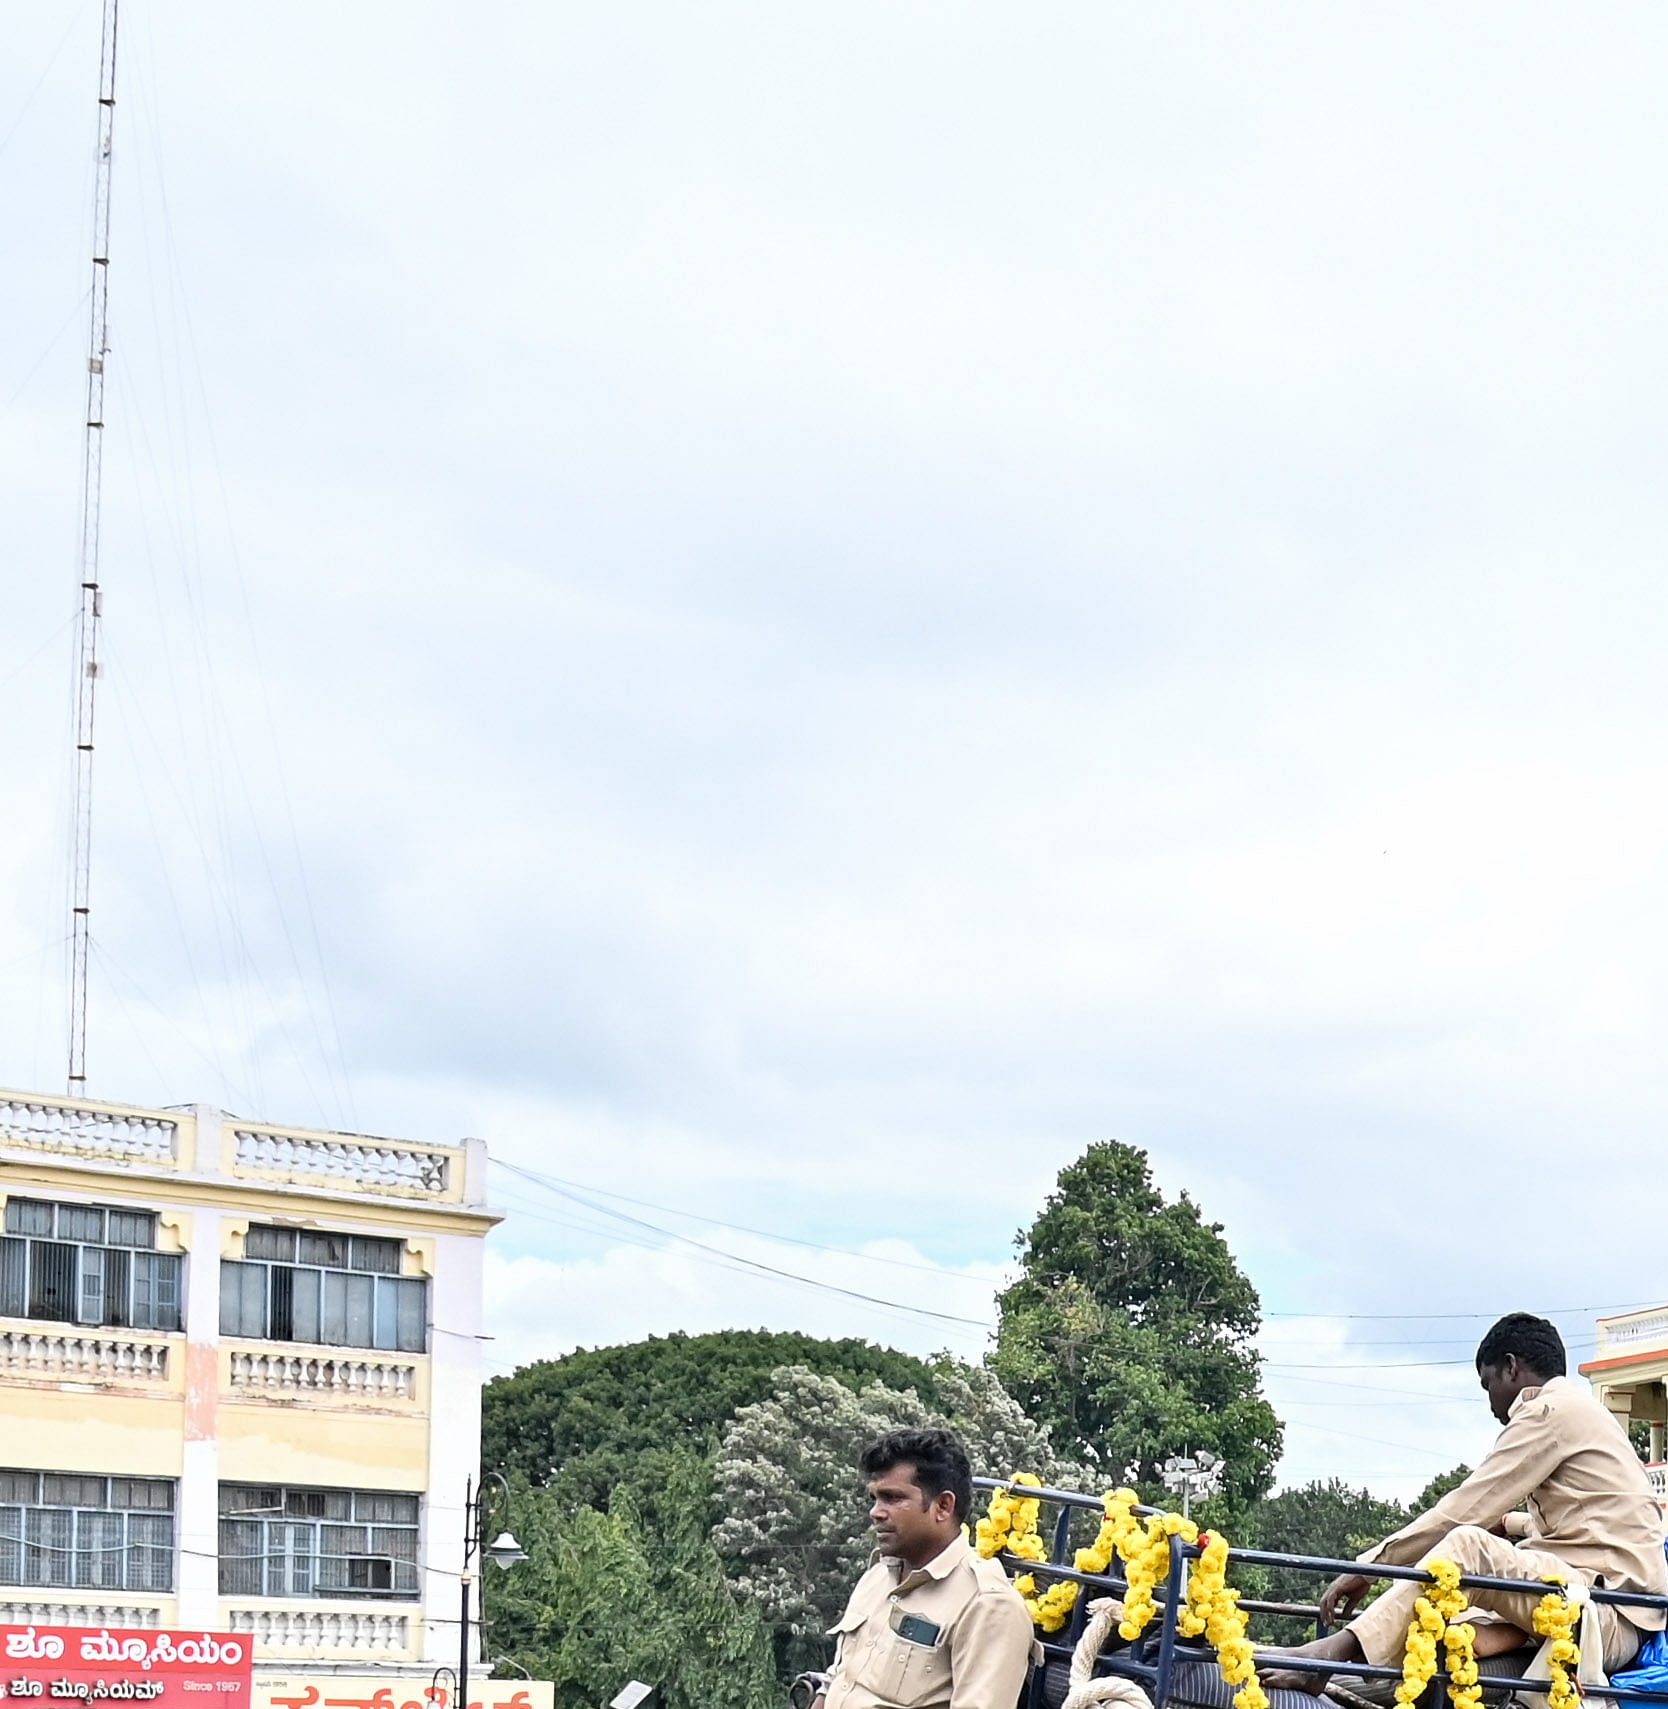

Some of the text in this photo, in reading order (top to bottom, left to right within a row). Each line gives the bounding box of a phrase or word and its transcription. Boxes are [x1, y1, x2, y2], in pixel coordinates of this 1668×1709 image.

[6, 1627, 243, 1671] ಶೂ ಮ್ಯೂಸಿಯಂ
[11, 1676, 44, 1698] ಶೂ
[51, 1677, 164, 1704] ಮ್ಯೂಸಿಯಮ್
[183, 1680, 241, 1693] Since 1967
